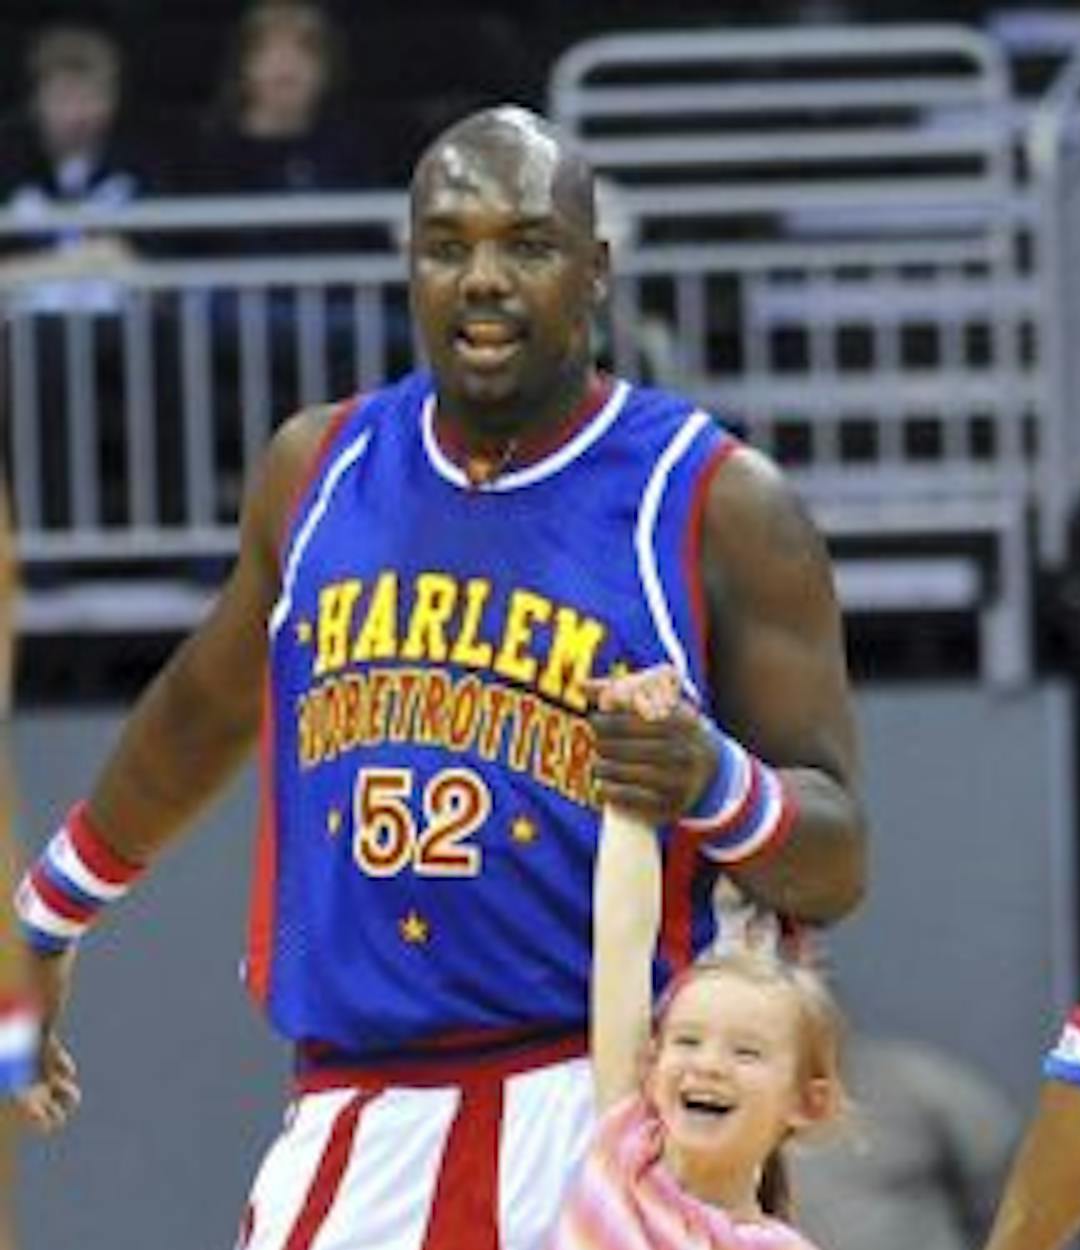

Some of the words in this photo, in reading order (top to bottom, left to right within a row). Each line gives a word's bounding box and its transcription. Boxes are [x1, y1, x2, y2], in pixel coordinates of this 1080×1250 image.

[314, 570, 605, 713] HARLEM
[299, 670, 604, 810] OBETROTTER
[354, 767, 490, 877] 52
